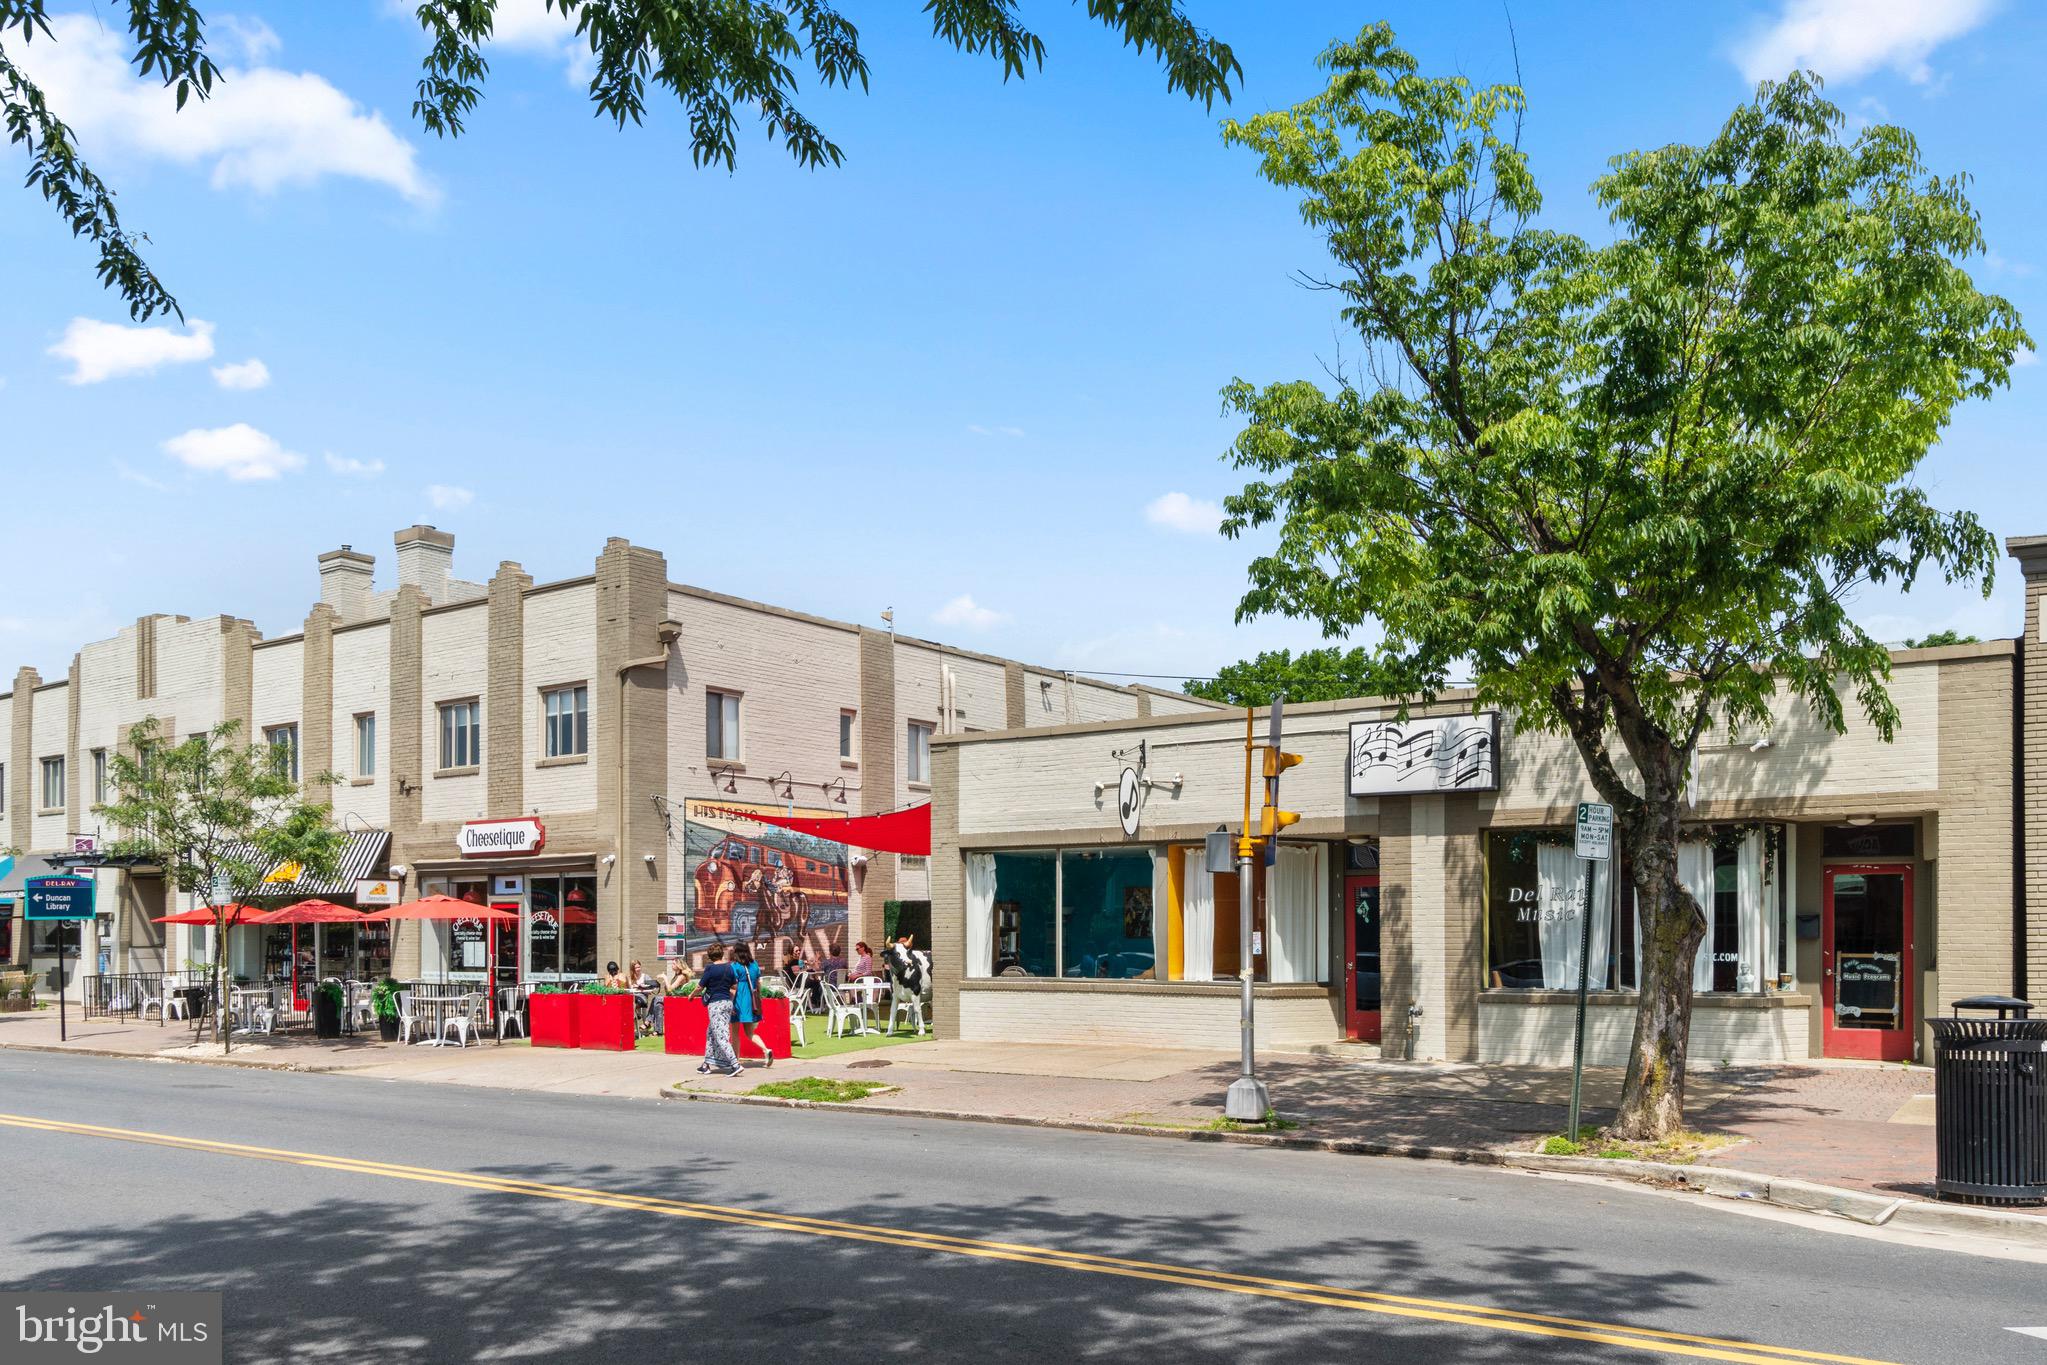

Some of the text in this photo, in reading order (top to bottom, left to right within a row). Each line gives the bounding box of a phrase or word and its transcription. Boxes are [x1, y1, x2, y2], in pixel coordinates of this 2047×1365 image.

[1579, 806, 1587, 820] 2
[1588, 806, 1605, 815] HOUR
[1588, 815, 1610, 823] PARKING
[1598, 826, 1609, 834] 5PM
[466, 828, 525, 850] Cheesetique
[1580, 832, 1608, 842] MON-SAT
[45, 894, 71, 902] Duncan
[1508, 884, 1586, 907] Del Ray
[45, 903, 71, 911] Library
[1517, 907, 1576, 922] Music
[1863, 973, 1891, 981] Programs
